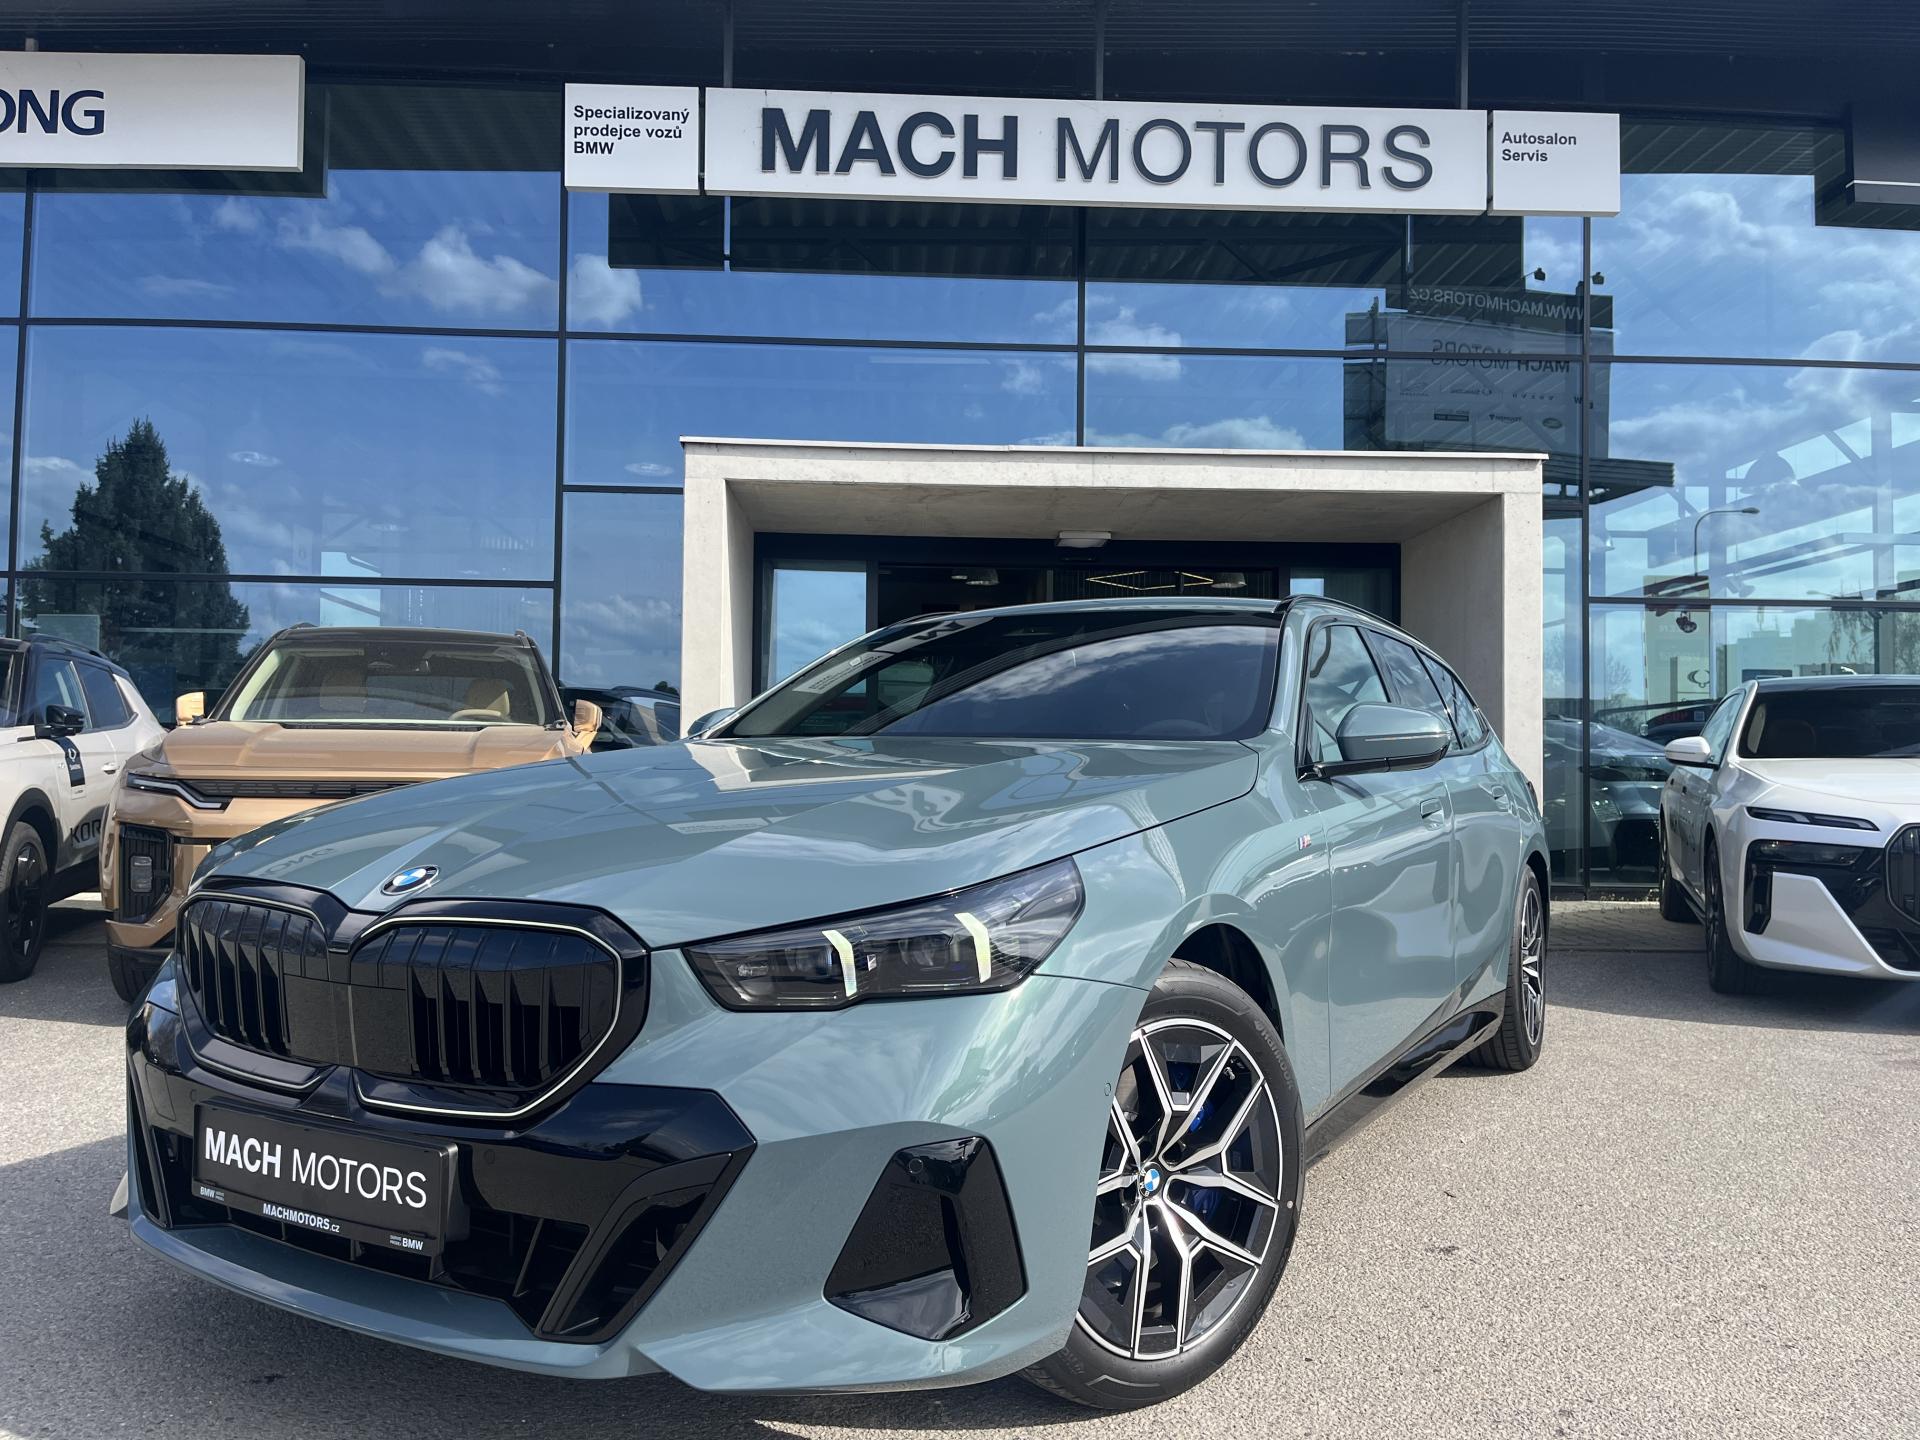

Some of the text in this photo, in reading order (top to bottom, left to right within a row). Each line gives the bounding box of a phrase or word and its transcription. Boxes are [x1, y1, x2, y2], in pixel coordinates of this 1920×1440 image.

[573, 105, 690, 124] Specializovaný
[573, 123, 682, 141] prodejce vozů
[1501, 131, 1577, 147] Autosalon
[573, 141, 614, 155] BMW
[761, 107, 1434, 191] MACH MOTORS
[1501, 148, 1548, 163] Servis
[205, 1127, 428, 1209] MACH MOTORS
[199, 1186, 216, 1199] BMW
[402, 1237, 424, 1251] BMW
